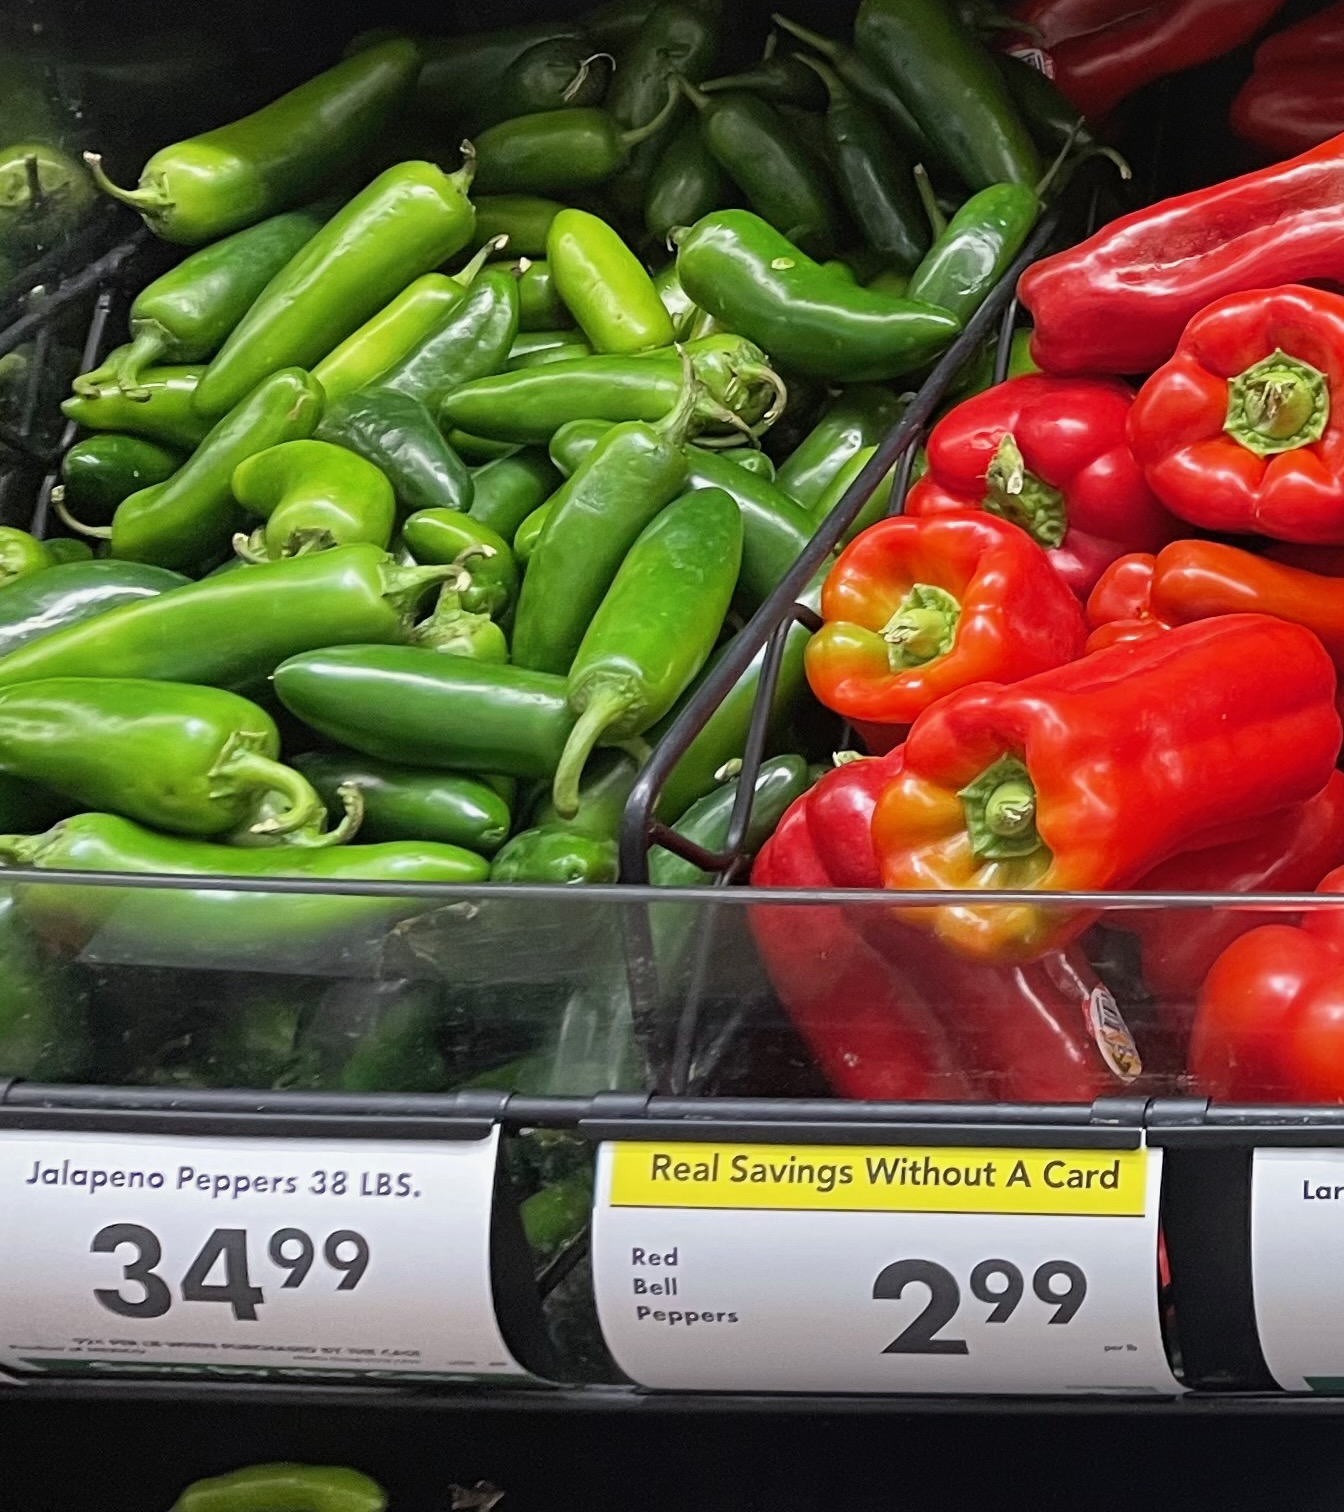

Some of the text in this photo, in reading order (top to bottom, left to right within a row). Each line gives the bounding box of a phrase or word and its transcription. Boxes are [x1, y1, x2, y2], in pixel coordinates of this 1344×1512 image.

[26, 1160, 420, 1199] Jalapeno Peppers 38 LBS.
[652, 1153, 1120, 1192] Real Savings Without A Card
[632, 1247, 677, 1266] Red
[634, 1277, 677, 1295] Bell
[637, 1306, 738, 1325] Peppers
